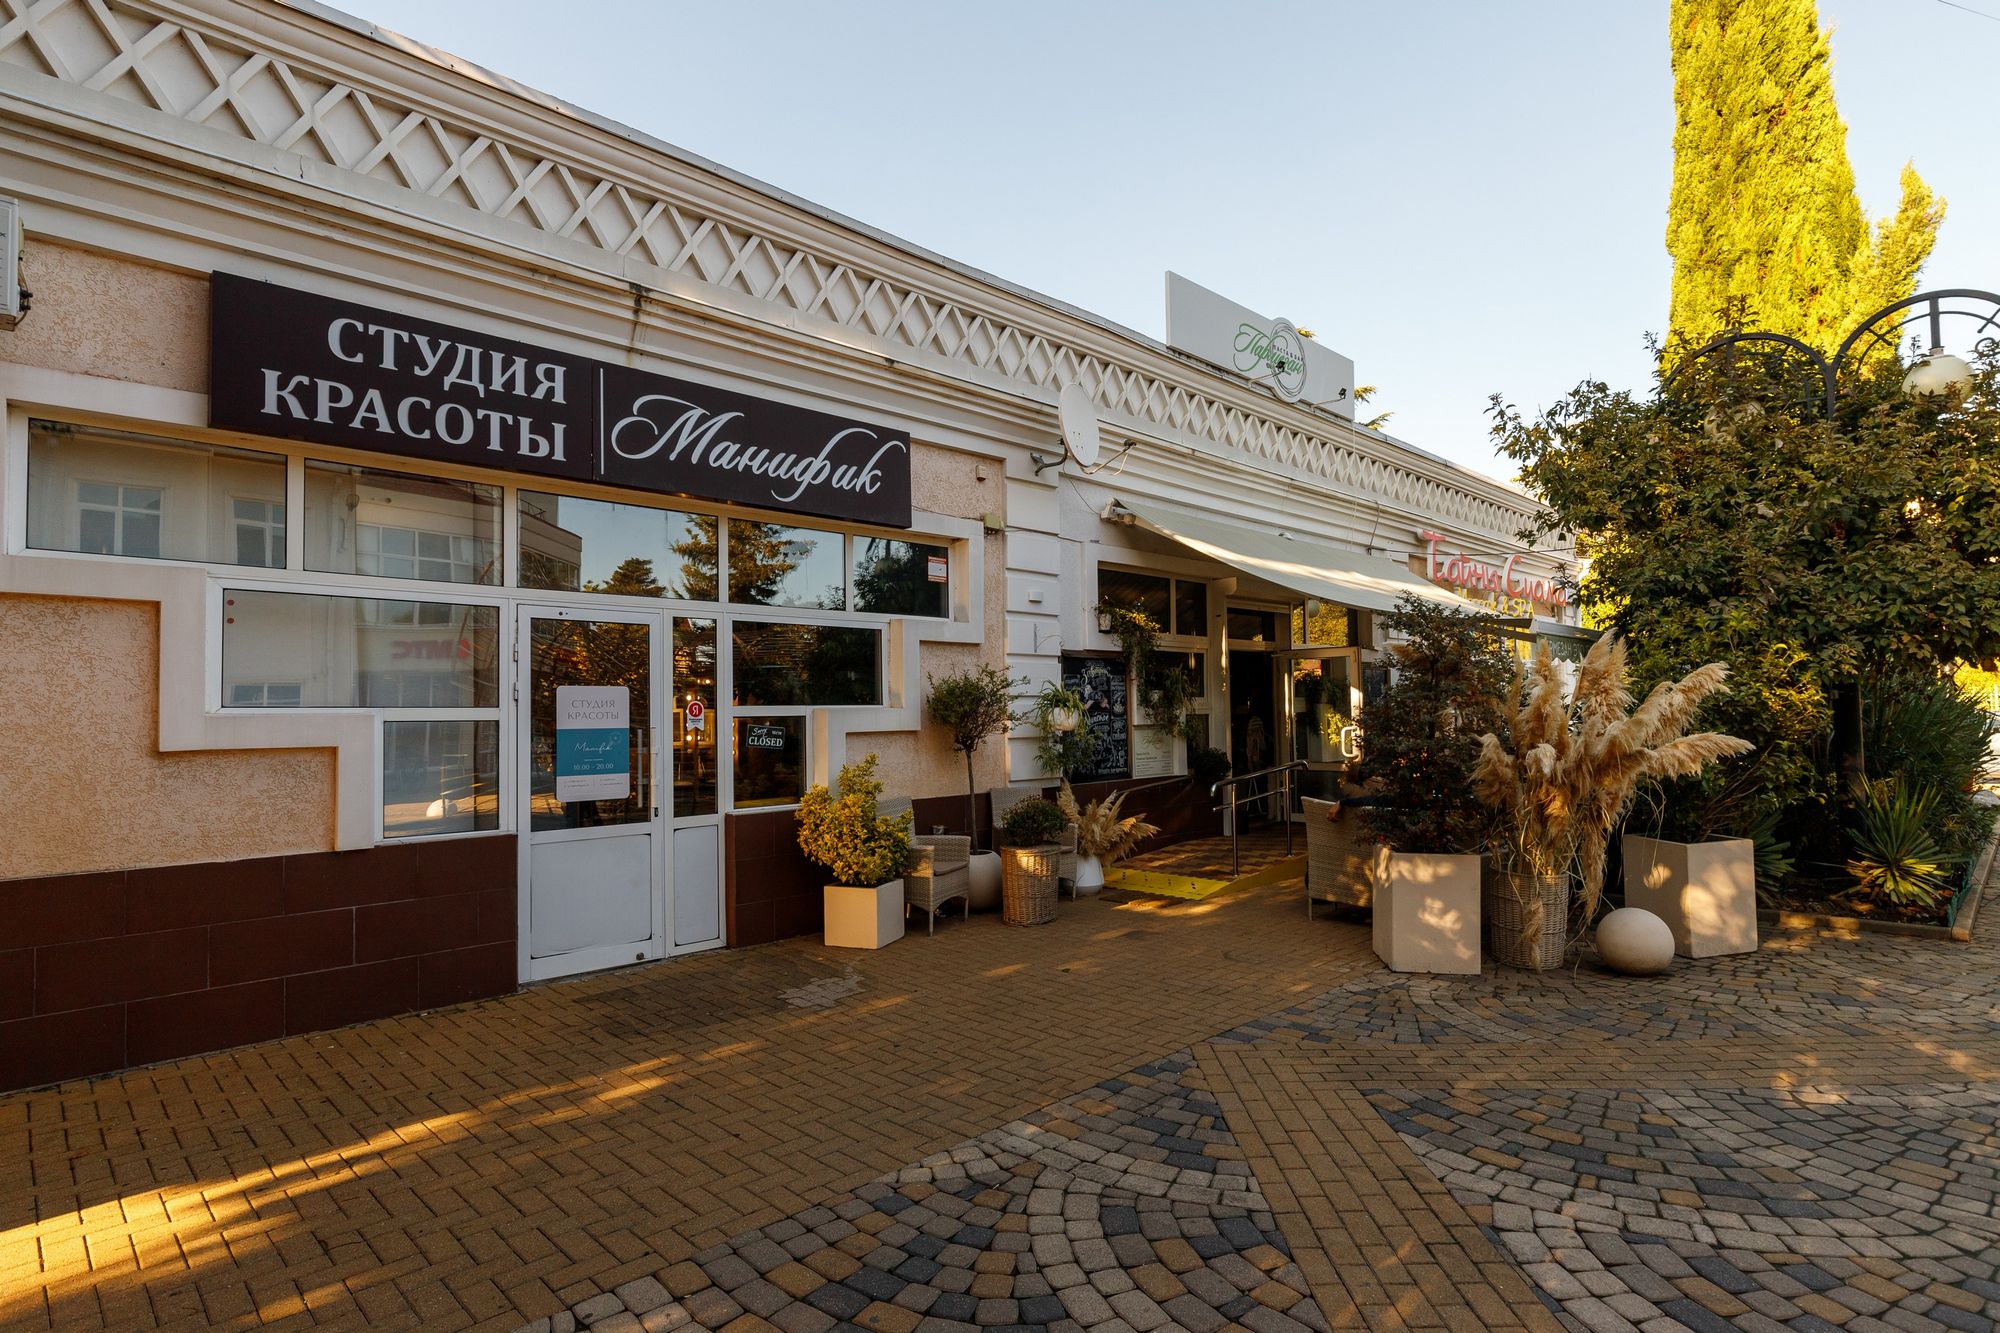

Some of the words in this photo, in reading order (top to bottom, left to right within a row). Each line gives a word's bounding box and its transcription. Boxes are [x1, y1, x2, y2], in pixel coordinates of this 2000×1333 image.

[328, 318, 567, 404] СТУДИЯ
[261, 368, 567, 462] КРАСОТЫ
[610, 394, 907, 503] Манифик
[1418, 530, 1501, 594] Тайны
[1513, 598, 1536, 618] SPA
[571, 699, 615, 709] СТУДИЯ
[692, 705, 699, 715] Я
[567, 711, 619, 720] КРАСОТЫ
[748, 736, 783, 747] CLOSED
[596, 762, 614, 770] 20.00
